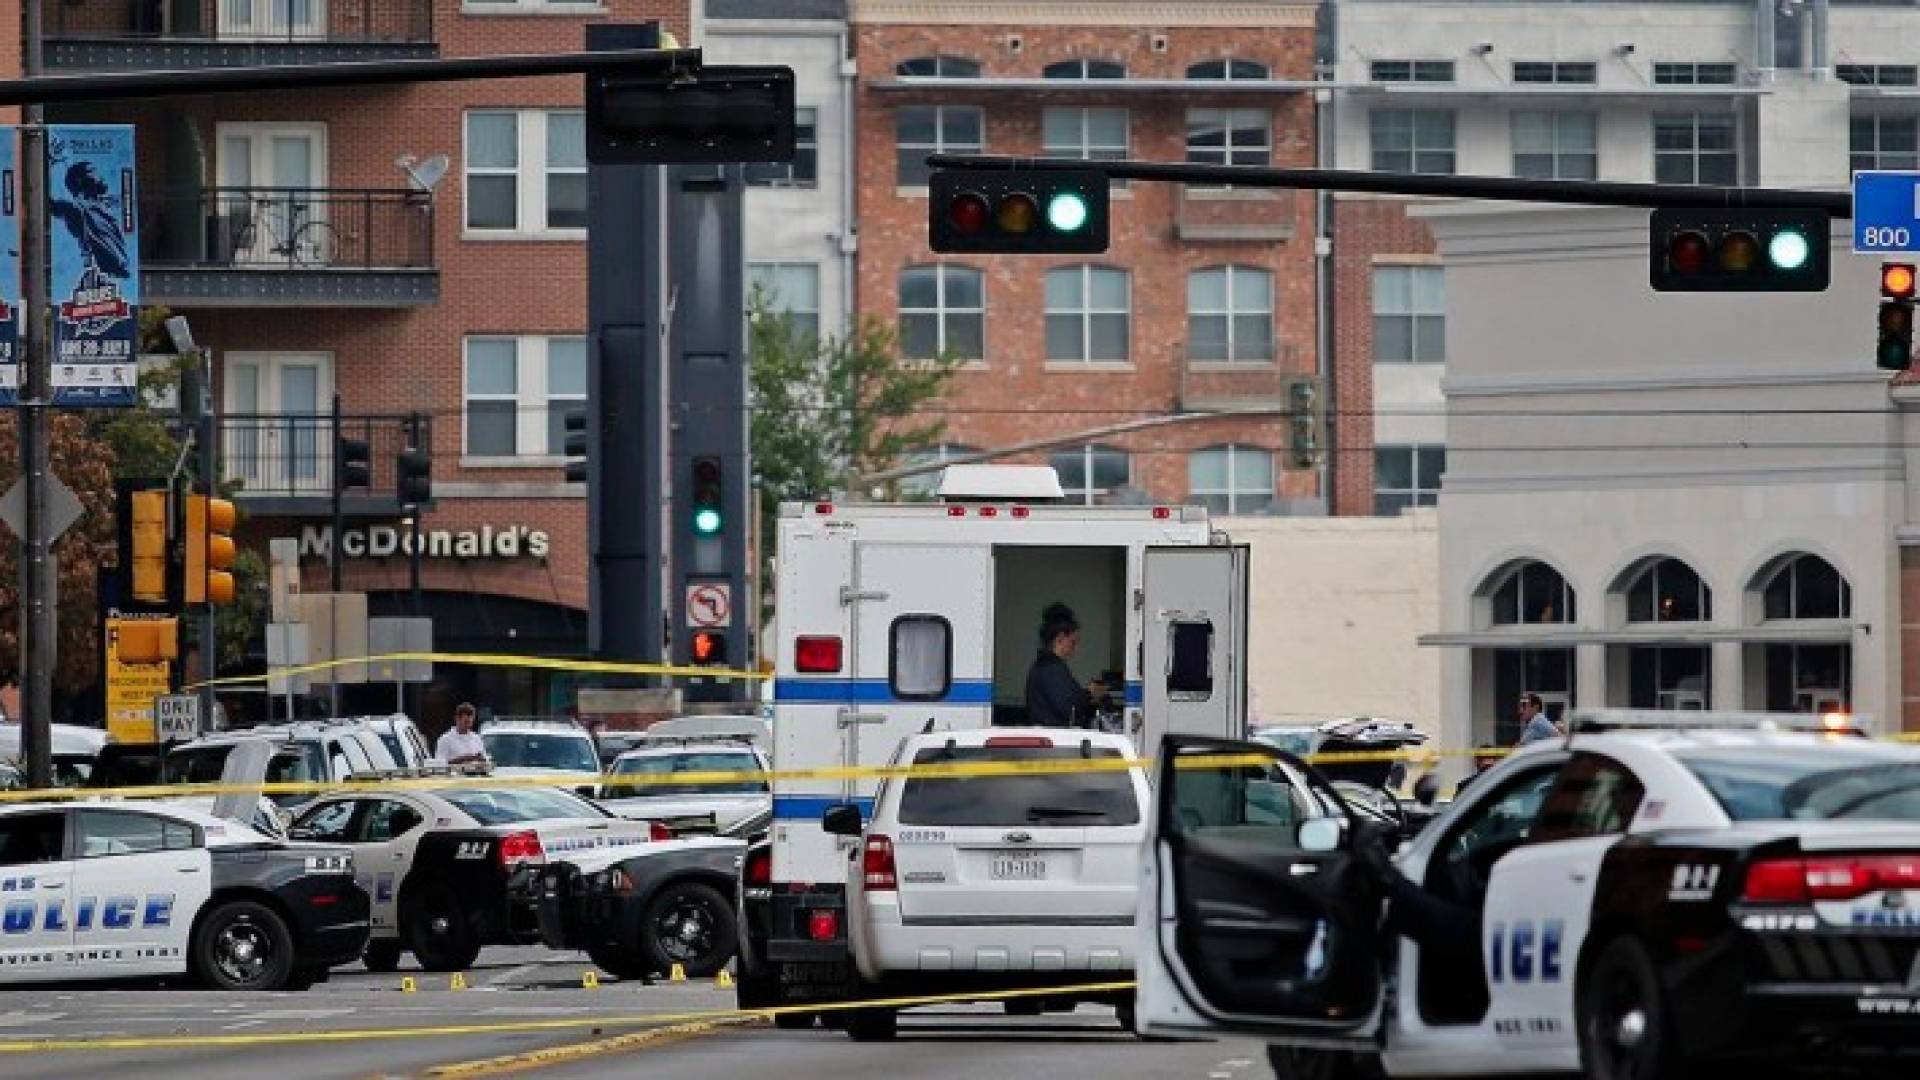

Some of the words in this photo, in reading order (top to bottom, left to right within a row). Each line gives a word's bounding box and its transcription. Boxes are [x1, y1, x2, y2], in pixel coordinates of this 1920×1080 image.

[1864, 226, 1910, 247] 800
[300, 525, 550, 558] McDonald's
[65, 950, 123, 961] SINCE
[1491, 919, 1565, 984] ICE
